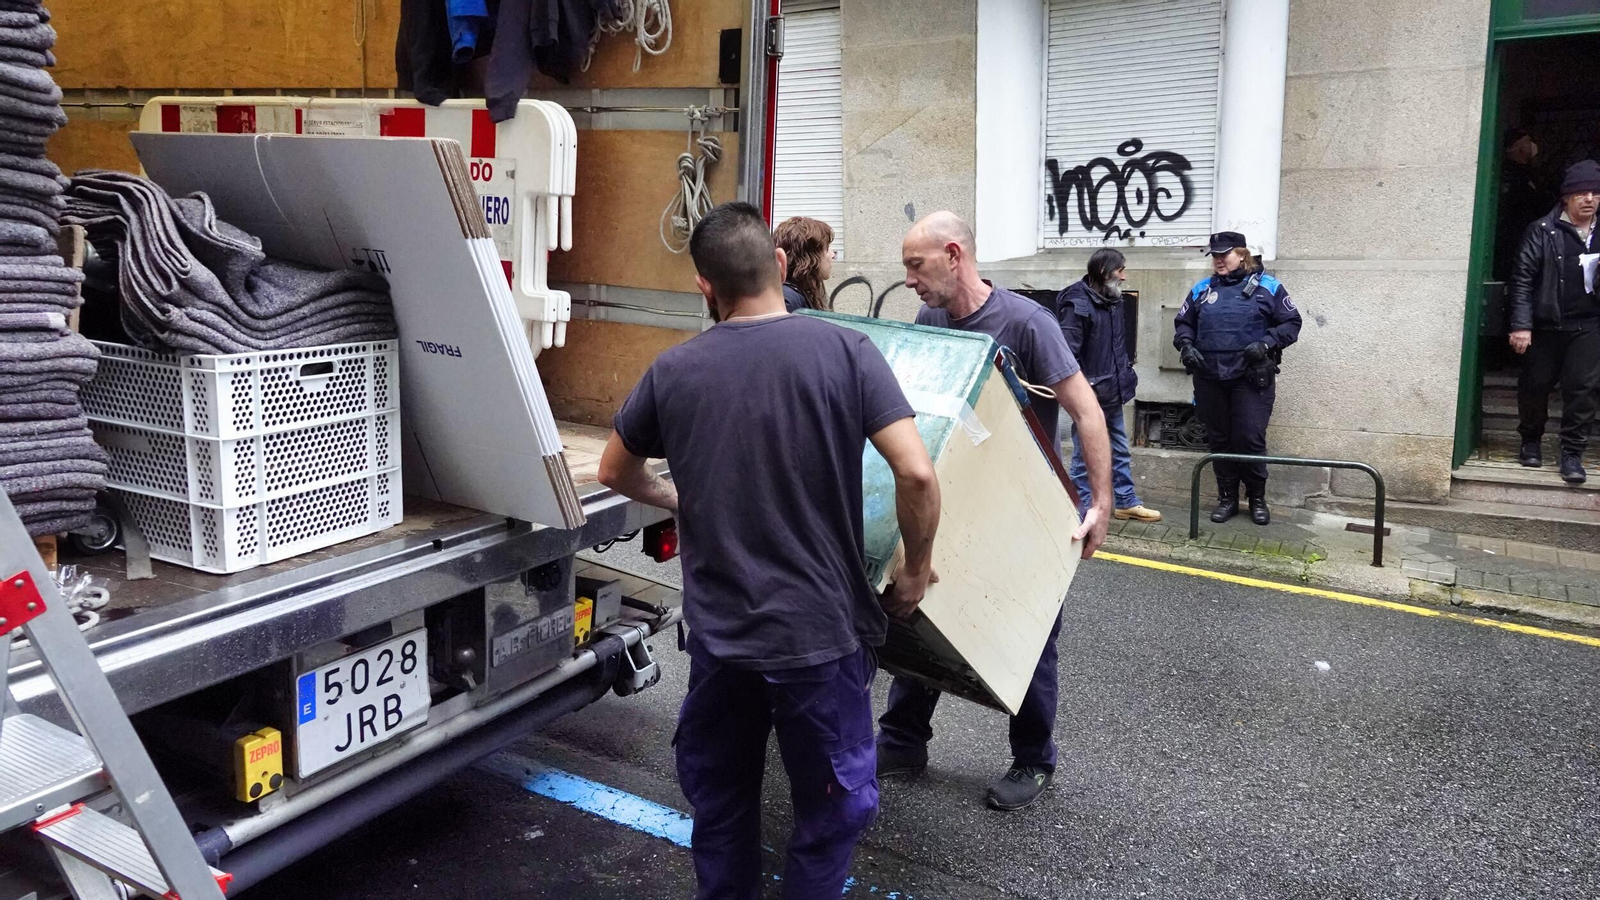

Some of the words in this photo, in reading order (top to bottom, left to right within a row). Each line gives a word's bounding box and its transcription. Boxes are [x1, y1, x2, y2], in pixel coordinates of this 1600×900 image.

[415, 340, 463, 358] FRAGIL
[575, 606, 592, 621] ZEPRO
[324, 639, 418, 706] 5028
[303, 702, 312, 716] E
[334, 693, 404, 753] JRB
[249, 740, 280, 765] ZEPRO
